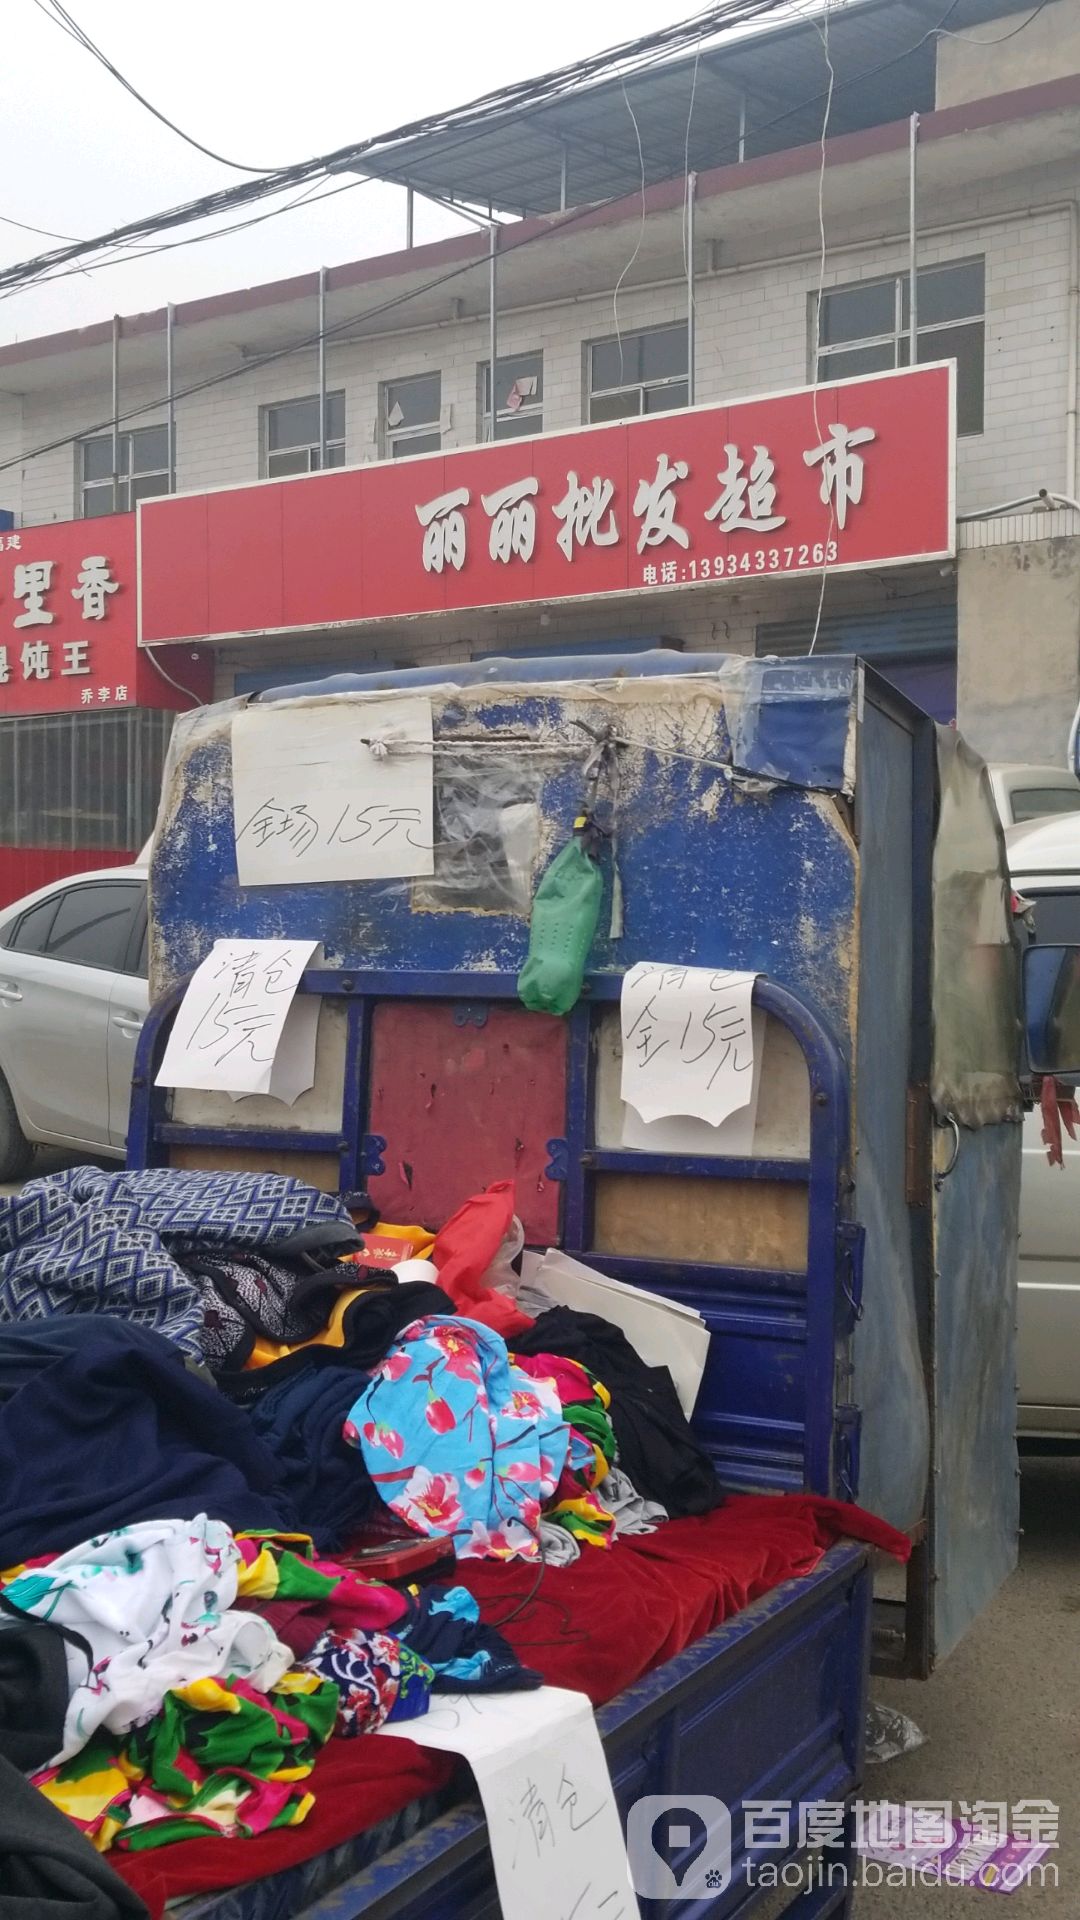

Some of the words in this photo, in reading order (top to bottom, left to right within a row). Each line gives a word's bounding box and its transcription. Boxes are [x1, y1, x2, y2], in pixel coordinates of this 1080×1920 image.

[416, 424, 875, 573] 丽丽批发超市
[0, 535, 21, 551] 建
[643, 541, 838, 585] 电话:13934337263
[81, 685, 128, 704] 乔李店
[214, 950, 300, 999] 清仓
